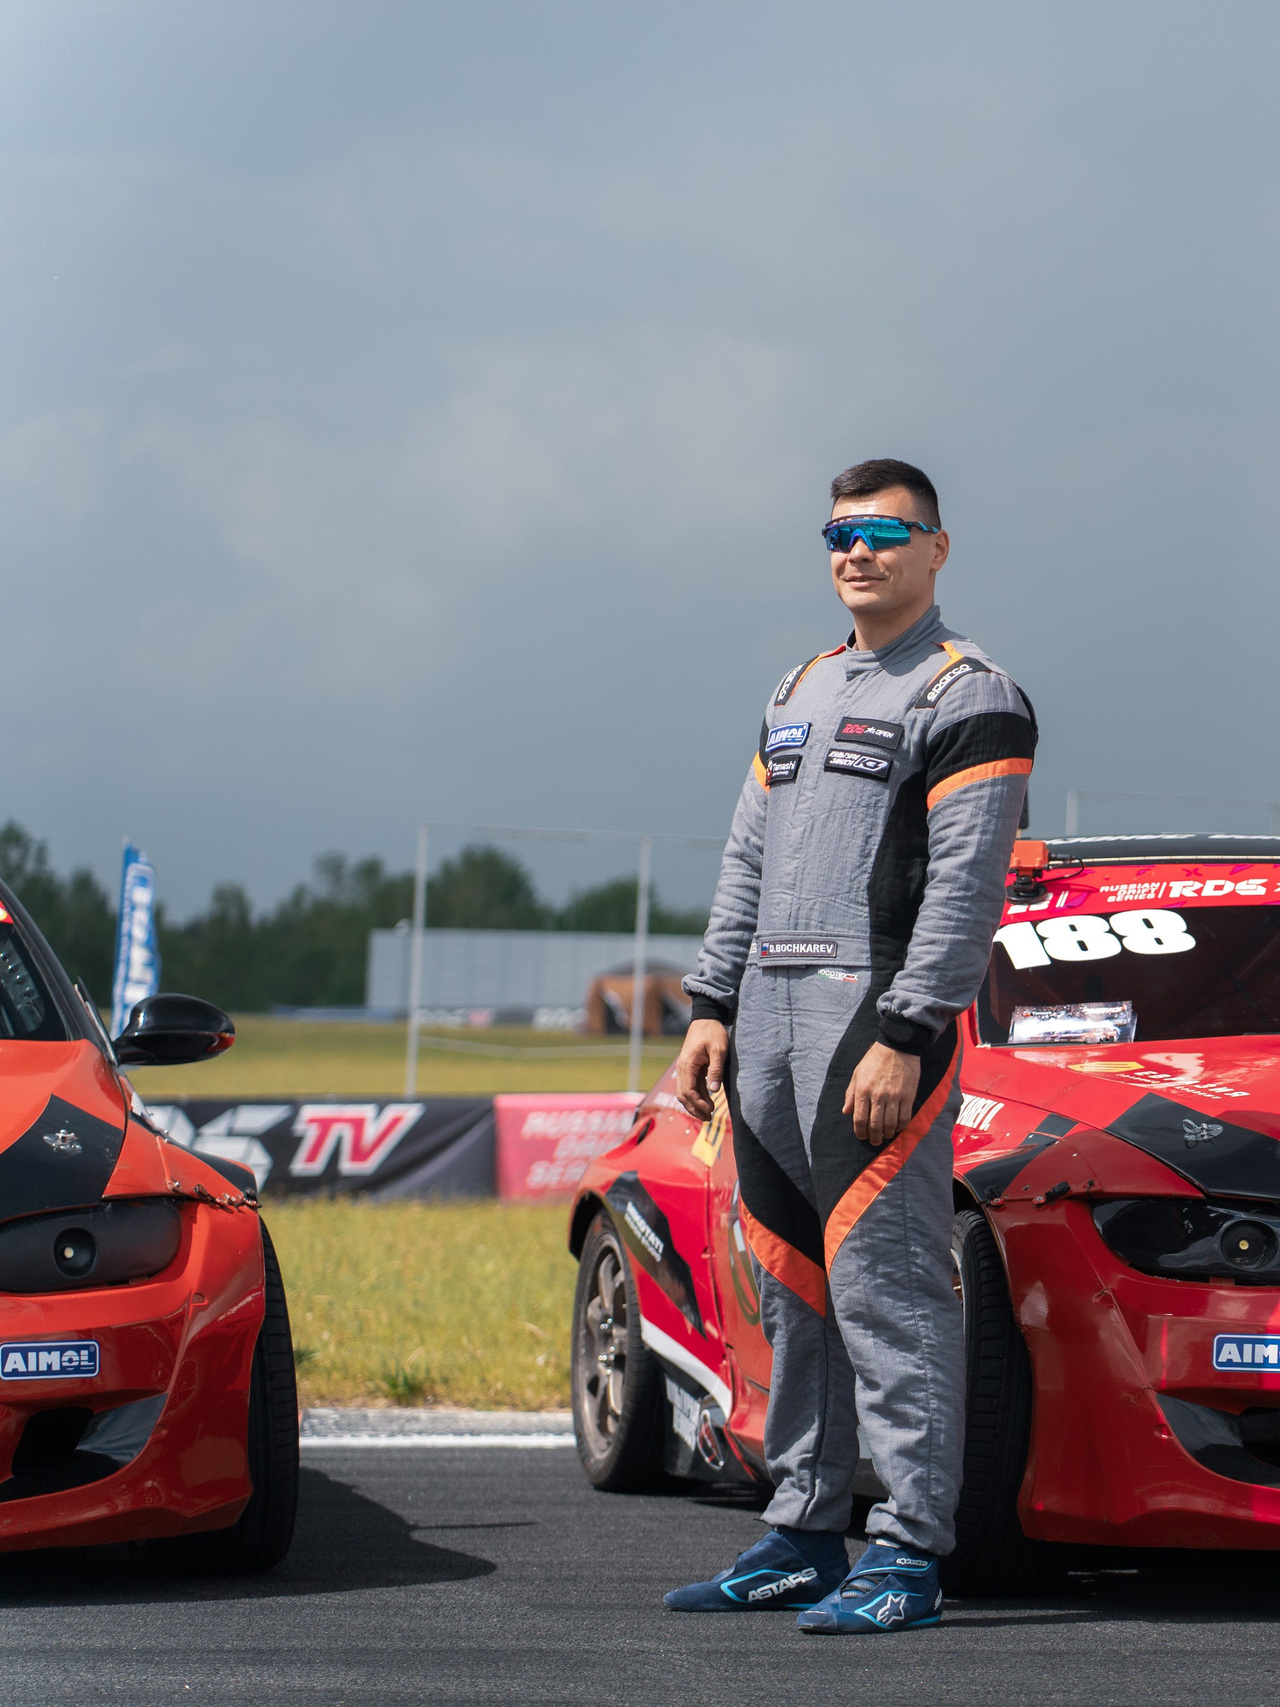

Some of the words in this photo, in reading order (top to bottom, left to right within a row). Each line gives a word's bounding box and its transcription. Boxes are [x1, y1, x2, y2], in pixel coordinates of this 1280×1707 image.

[842, 723, 868, 735] RDS
[875, 728, 895, 739] OPEN
[1168, 878, 1269, 898] RDS
[769, 943, 834, 954] D.BOCHKAREV
[992, 908, 1197, 970] 188
[291, 1104, 424, 1176] TV
[3, 1349, 95, 1373] AIMOL
[748, 1566, 818, 1602] ASTARS
